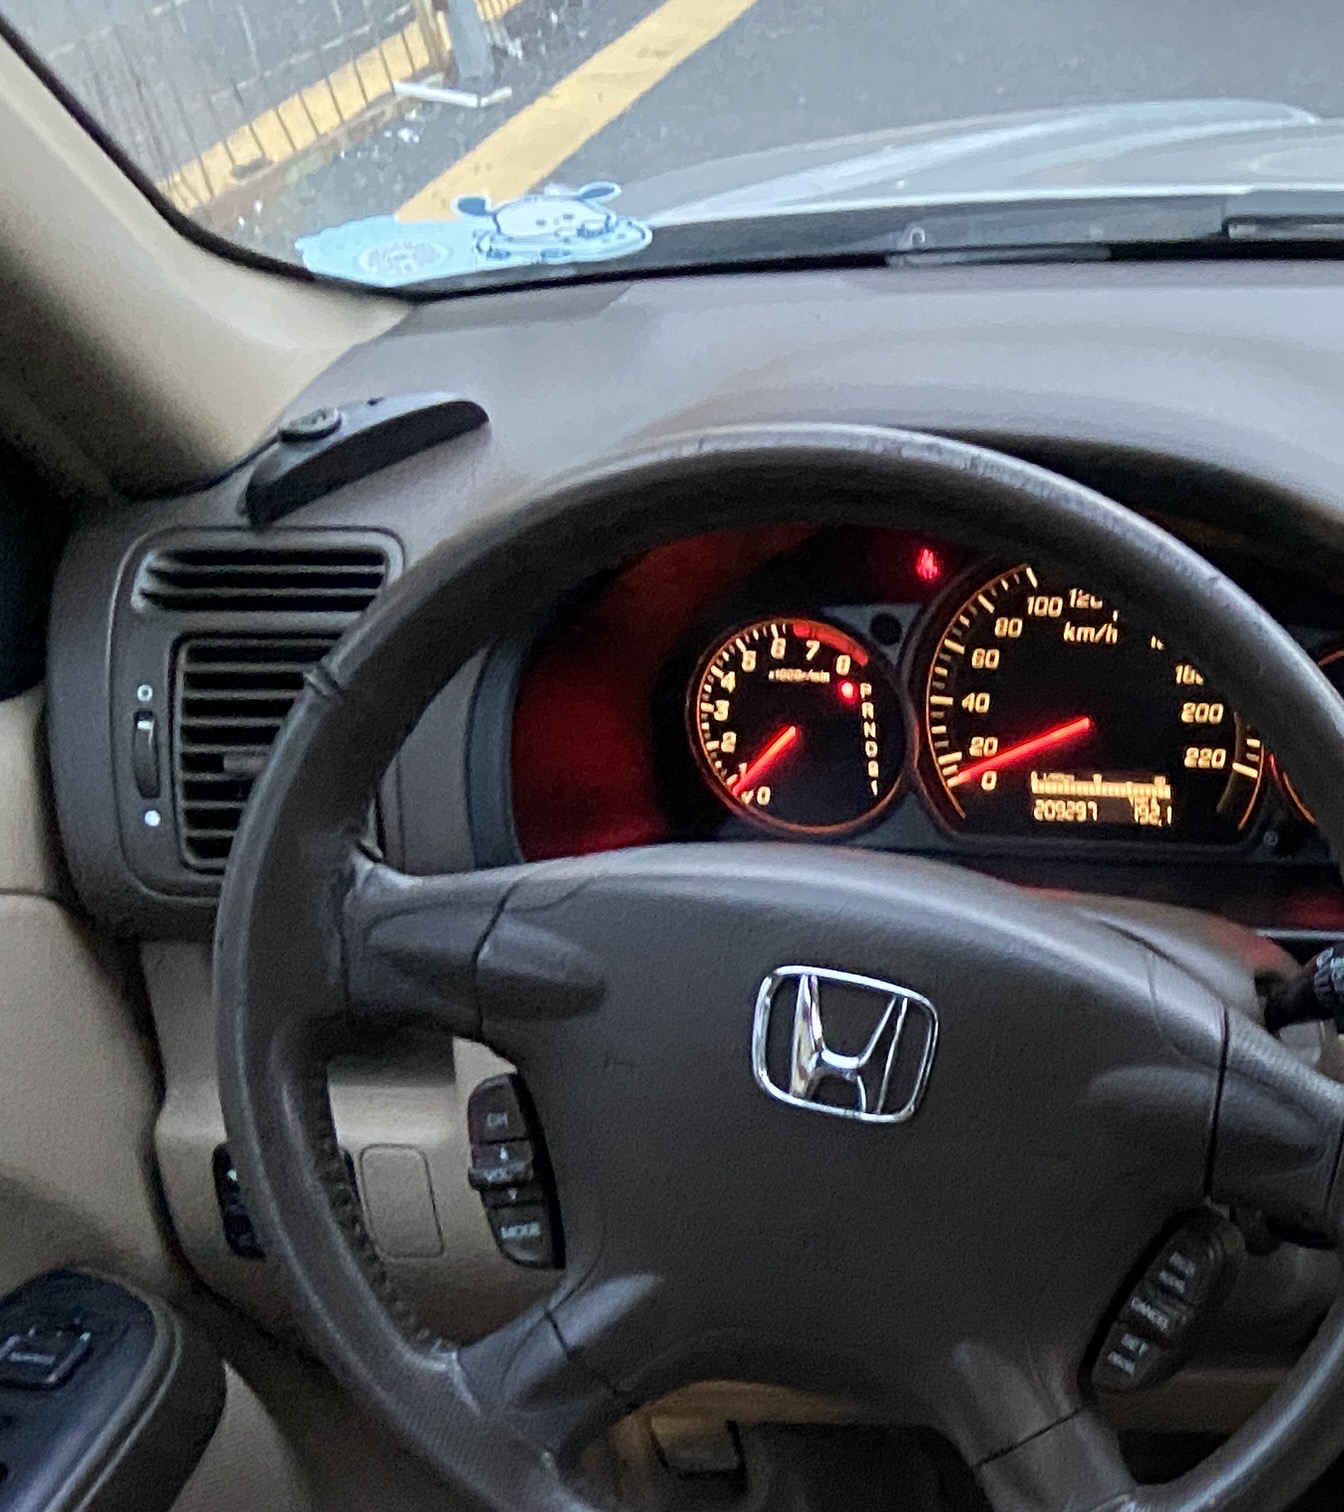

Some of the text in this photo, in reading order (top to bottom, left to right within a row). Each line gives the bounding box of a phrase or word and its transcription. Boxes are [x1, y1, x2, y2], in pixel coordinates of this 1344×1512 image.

[1027, 596, 1063, 617] 100
[994, 617, 1023, 638] 80
[1063, 621, 1118, 644] km/h
[806, 640, 820, 661] 7
[971, 648, 1000, 670] 60
[720, 671, 736, 693] 4
[961, 693, 990, 713] 40
[1181, 702, 1224, 724] 200
[969, 736, 998, 757] 20
[1184, 747, 1227, 769] 220
[981, 770, 997, 791] 0
[756, 786, 771, 806] 0
